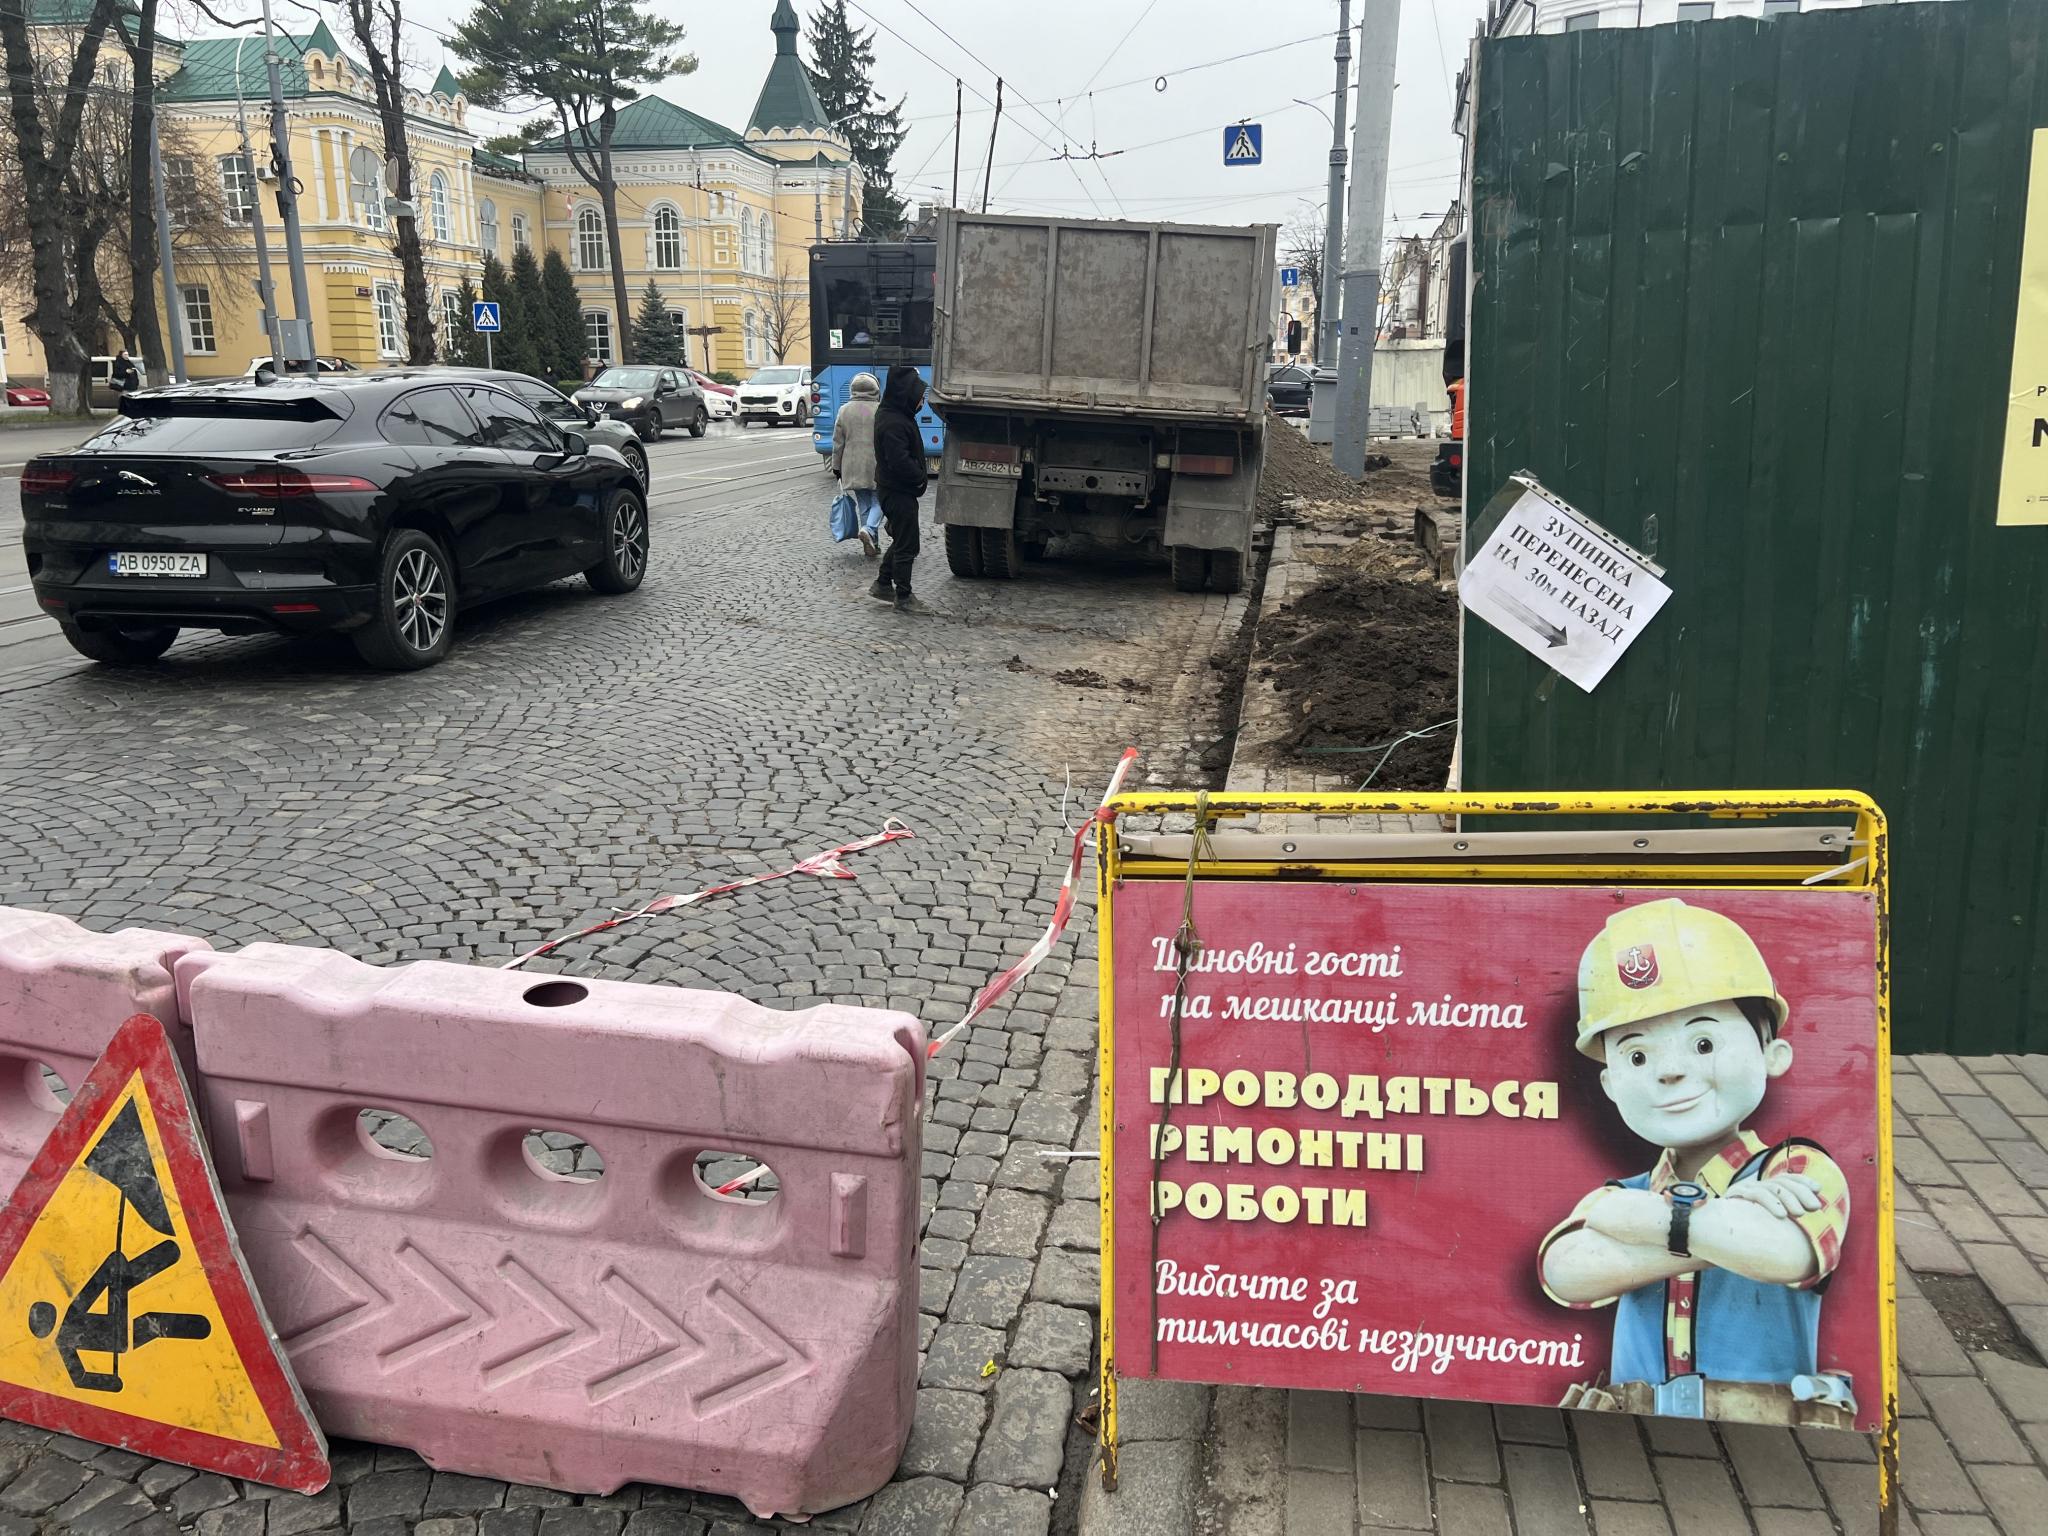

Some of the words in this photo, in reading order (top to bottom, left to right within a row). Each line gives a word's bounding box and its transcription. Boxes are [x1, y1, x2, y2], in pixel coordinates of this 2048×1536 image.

[118, 555, 138, 571] AB
[142, 555, 175, 571] 0950
[179, 556, 201, 571] ZA
[1509, 524, 1634, 621] ПЕРЕНЕСЕНА
[1543, 515, 1633, 587] ЗУПИНКА
[1492, 543, 1519, 571] НА
[1560, 590, 1625, 645] НАЗАД
[1304, 945, 1403, 977] гості
[1160, 994, 1212, 1019] та
[1221, 992, 1400, 1033] мешканці
[1407, 994, 1528, 1029] міста
[1150, 1067, 1559, 1119] ПРОВОДЯТЬСЯ
[1150, 1124, 1424, 1171] РЕМОНТНІ
[1150, 1181, 1367, 1227] РОБОТИ
[1156, 1259, 1308, 1301] Вибачте
[1312, 1278, 1359, 1319] за
[1156, 1317, 1351, 1351] тимчасові
[1358, 1330, 1584, 1374] незручності
